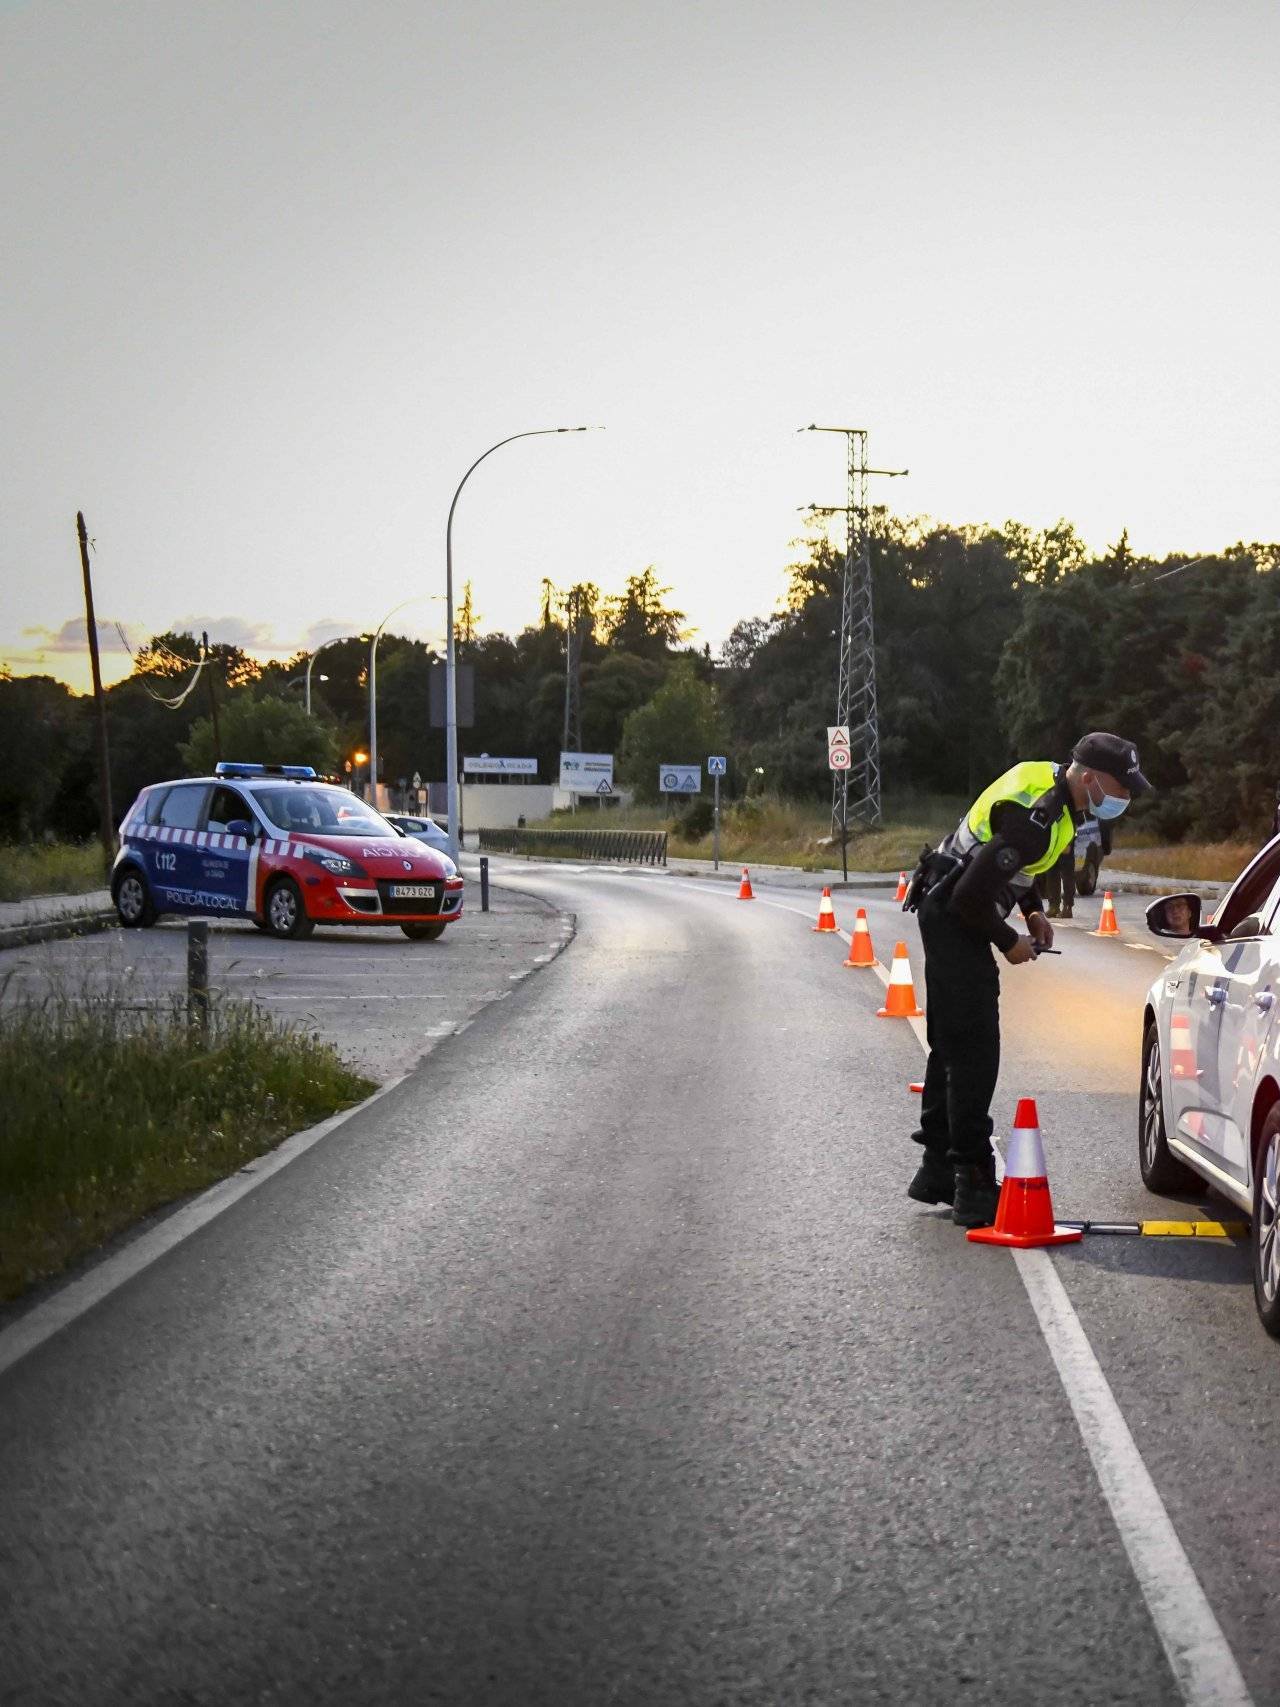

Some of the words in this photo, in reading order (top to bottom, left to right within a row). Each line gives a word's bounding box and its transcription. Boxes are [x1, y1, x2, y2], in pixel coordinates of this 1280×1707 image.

[160, 853, 177, 871] 112
[166, 890, 203, 906] POLICIA
[205, 894, 240, 911] LOCAL
[395, 886, 416, 897] 8473
[418, 886, 433, 897] GZC
